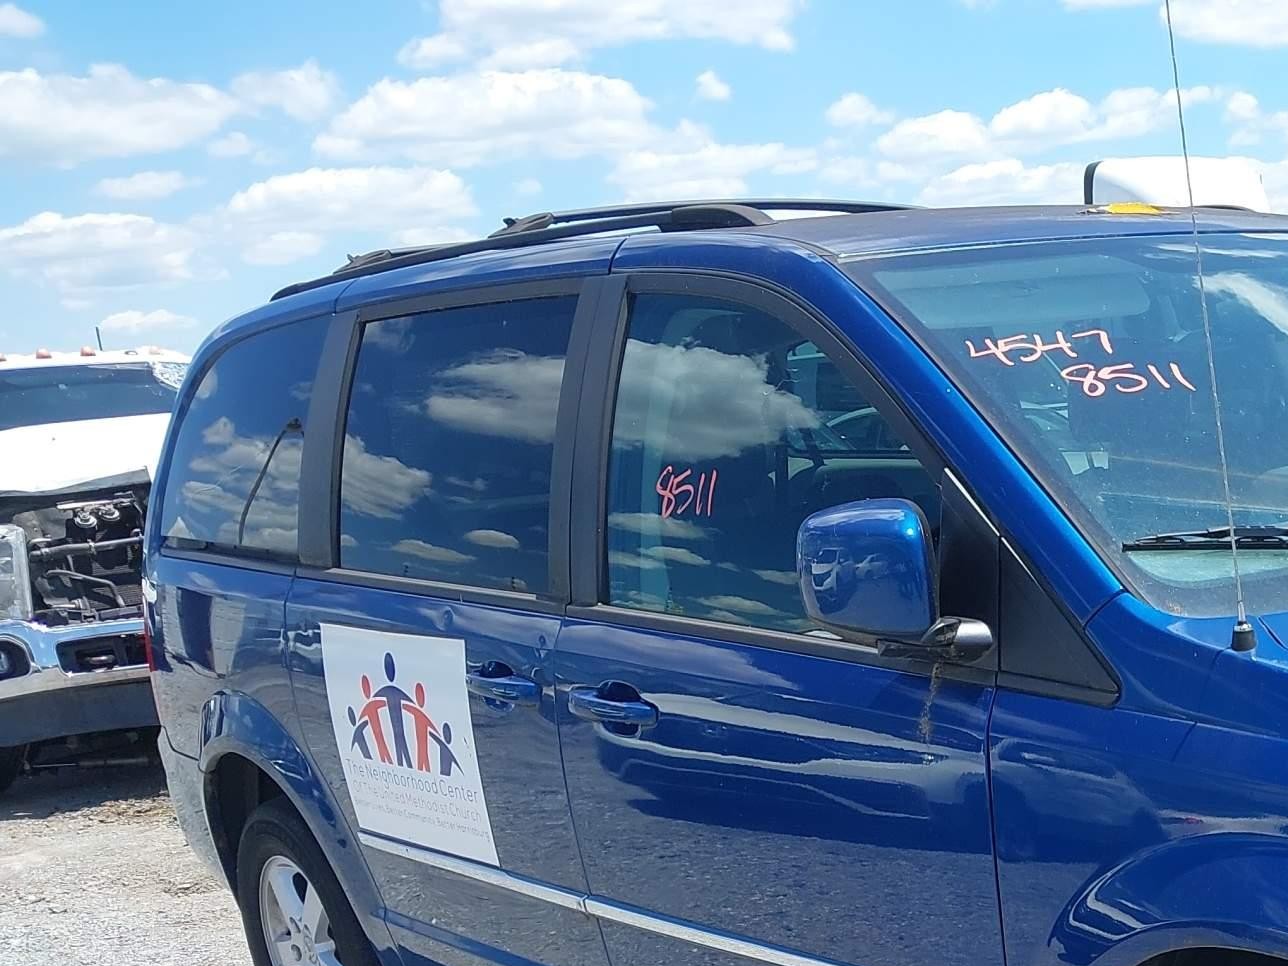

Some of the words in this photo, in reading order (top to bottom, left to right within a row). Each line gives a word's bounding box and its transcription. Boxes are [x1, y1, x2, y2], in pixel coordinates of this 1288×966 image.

[964, 329, 1113, 366] 4547
[1060, 362, 1197, 397] 8511
[655, 465, 718, 520] 8511
[345, 758, 366, 777] The
[365, 763, 438, 795] Neighborhood
[439, 778, 478, 804] Center
[404, 791, 450, 816] Methodist
[449, 803, 482, 823] Church
